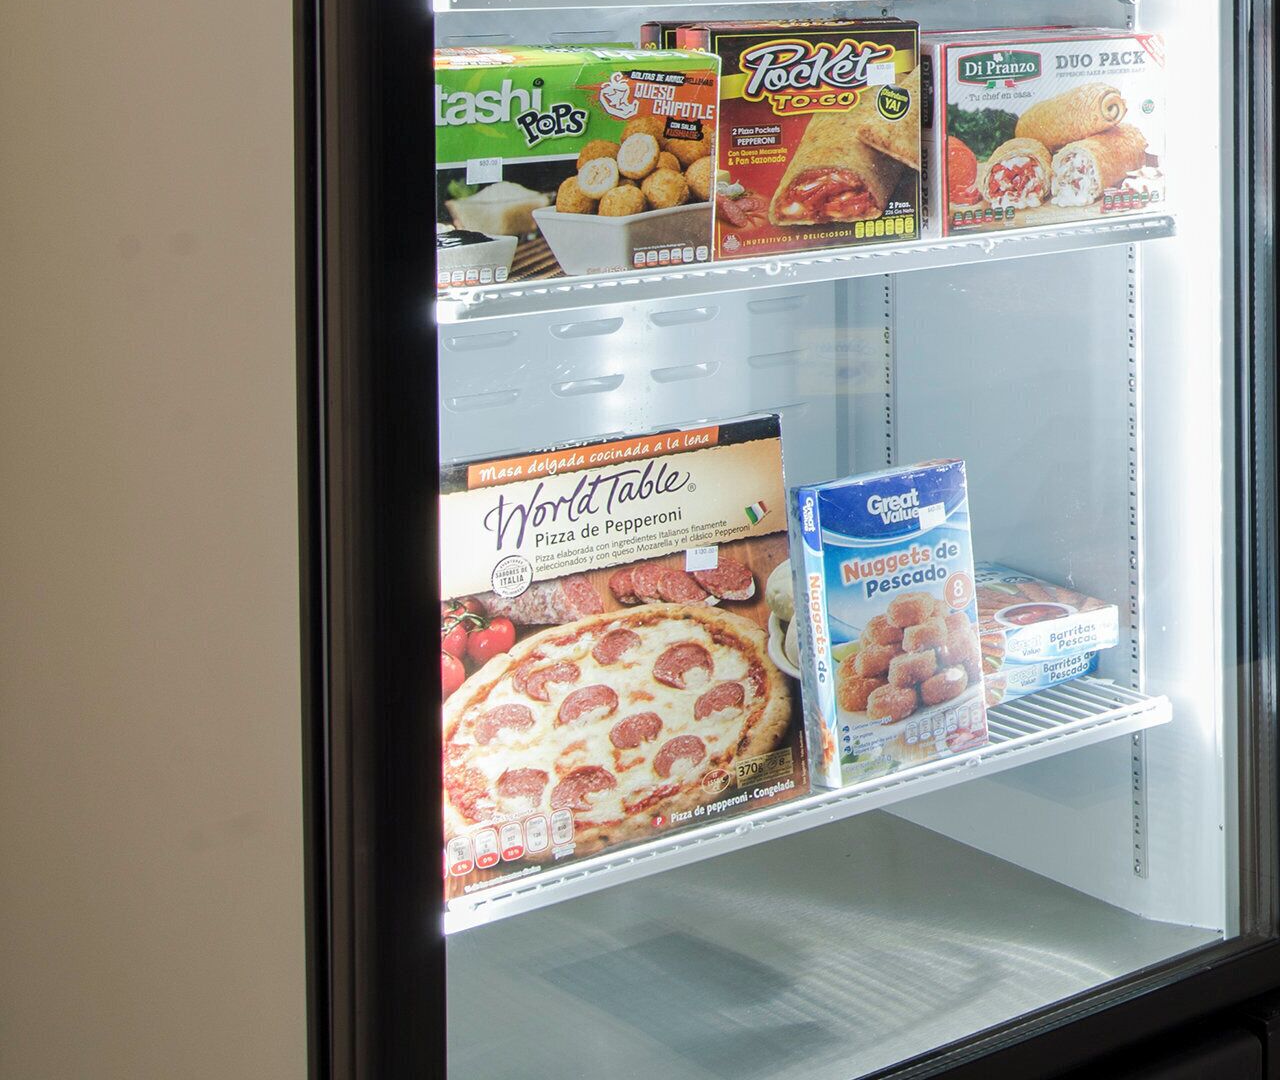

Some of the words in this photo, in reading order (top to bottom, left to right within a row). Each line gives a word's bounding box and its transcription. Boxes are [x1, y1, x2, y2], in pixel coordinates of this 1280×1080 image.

[965, 61, 982, 76] Di
[985, 59, 1035, 75] Pranzo
[1056, 54, 1093, 70] DUO
[1099, 50, 1146, 66] PACK
[656, 72, 664, 81] DE
[634, 83, 676, 100] QUESO
[969, 93, 981, 102] Tu
[982, 91, 998, 101] chef
[1014, 91, 1031, 99] casa
[653, 100, 715, 119] CHIPOTLE
[517, 103, 587, 144] POPS
[732, 128, 738, 136] 2
[738, 127, 754, 135] Pizza
[755, 126, 781, 135] Pockets
[737, 137, 775, 146] PEPPERONI
[728, 158, 734, 166] &
[735, 157, 749, 166] Pan
[751, 155, 786, 165] Sazonado
[740, 149, 758, 157] Queso
[803, 230, 852, 241] DELICIOSOS!
[479, 465, 523, 482] Masa
[527, 455, 585, 475] delgada
[589, 444, 650, 463] cocinada
[654, 444, 663, 453] a
[666, 438, 680, 450] la
[683, 432, 710, 448] leña
[867, 488, 920, 515] Great
[880, 507, 920, 525] Value
[535, 530, 575, 548] Pizza
[581, 525, 599, 539] de
[605, 507, 683, 533] Pepperoni
[535, 551, 555, 563] Pizza
[557, 545, 594, 560] elaborada
[596, 543, 610, 552] con
[611, 534, 657, 550] ingredientes
[659, 526, 690, 541] Italianos
[691, 520, 728, 533] finamente
[535, 558, 587, 573] seleccionados
[596, 554, 609, 563] con
[611, 548, 634, 562] queso
[636, 540, 673, 554] Mozarella
[674, 539, 680, 547] y
[681, 535, 688, 544] el
[690, 531, 713, 542] clásico
[714, 523, 751, 538] Pepperoni
[843, 547, 930, 584] Nuggets
[936, 543, 958, 559] de
[495, 568, 519, 579] SABORES
[520, 567, 528, 575] DE
[500, 574, 524, 586] ITALIA
[866, 564, 947, 599] Pescado
[953, 580, 963, 596] 8
[809, 575, 825, 656] Nuggets
[818, 660, 826, 684] de
[1050, 624, 1096, 643] Barritas
[1044, 655, 1082, 673] Barritas
[1050, 662, 1088, 681] Pescado
[656, 817, 663, 825] P
[670, 811, 692, 823] Pizza
[694, 805, 705, 816] de
[706, 792, 748, 815] pepperoni
[753, 779, 795, 799] Congelada
